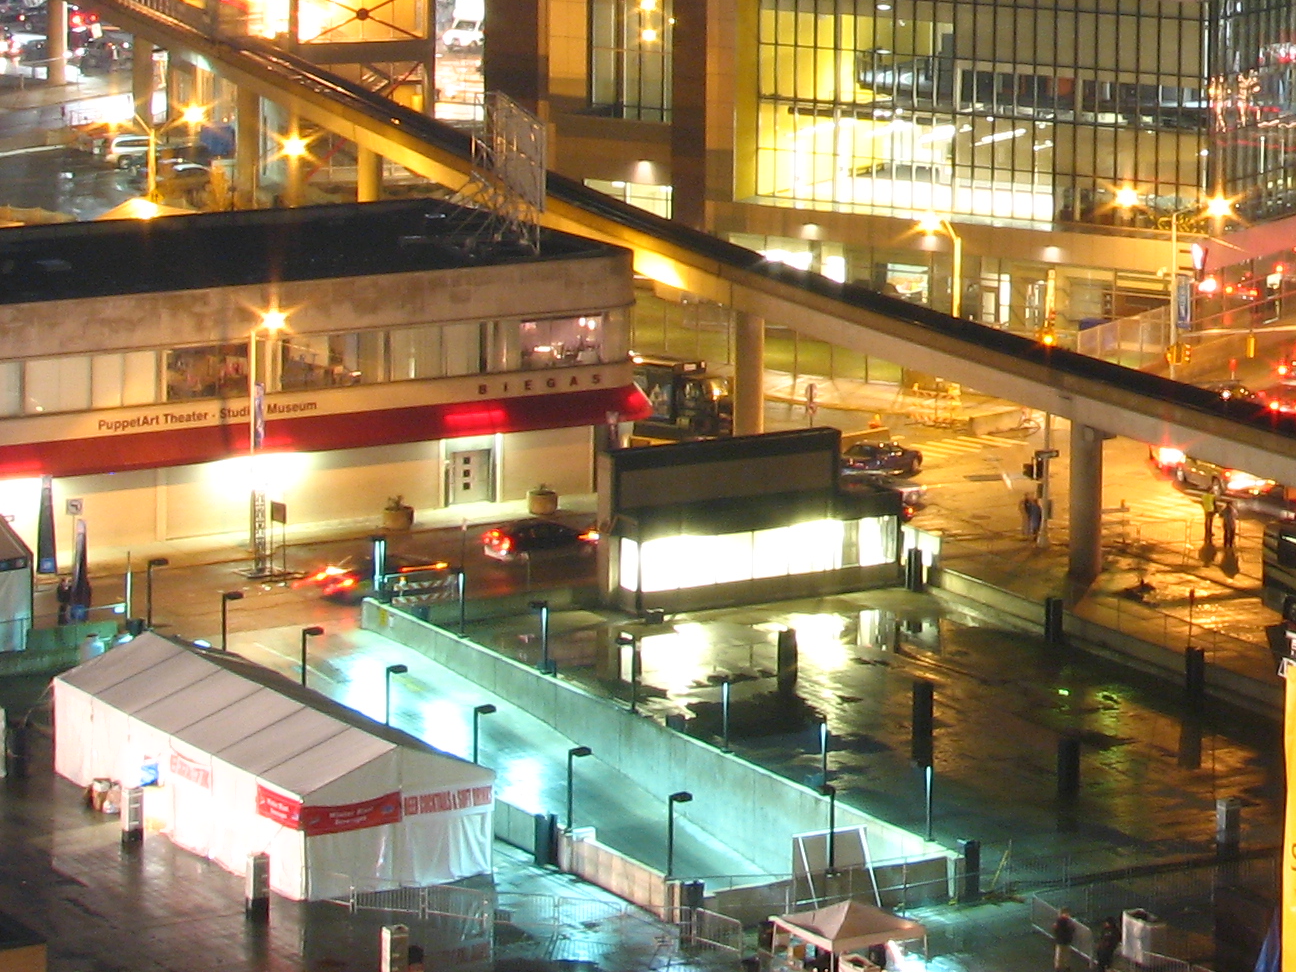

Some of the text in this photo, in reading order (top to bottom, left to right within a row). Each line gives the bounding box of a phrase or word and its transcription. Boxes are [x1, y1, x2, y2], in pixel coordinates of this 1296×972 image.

[478, 374, 601, 395] BIEGAS
[98, 414, 160, 432] PuppetArt
[163, 410, 209, 425] Theater
[219, 404, 251, 420] Studi
[267, 401, 318, 415] Museum
